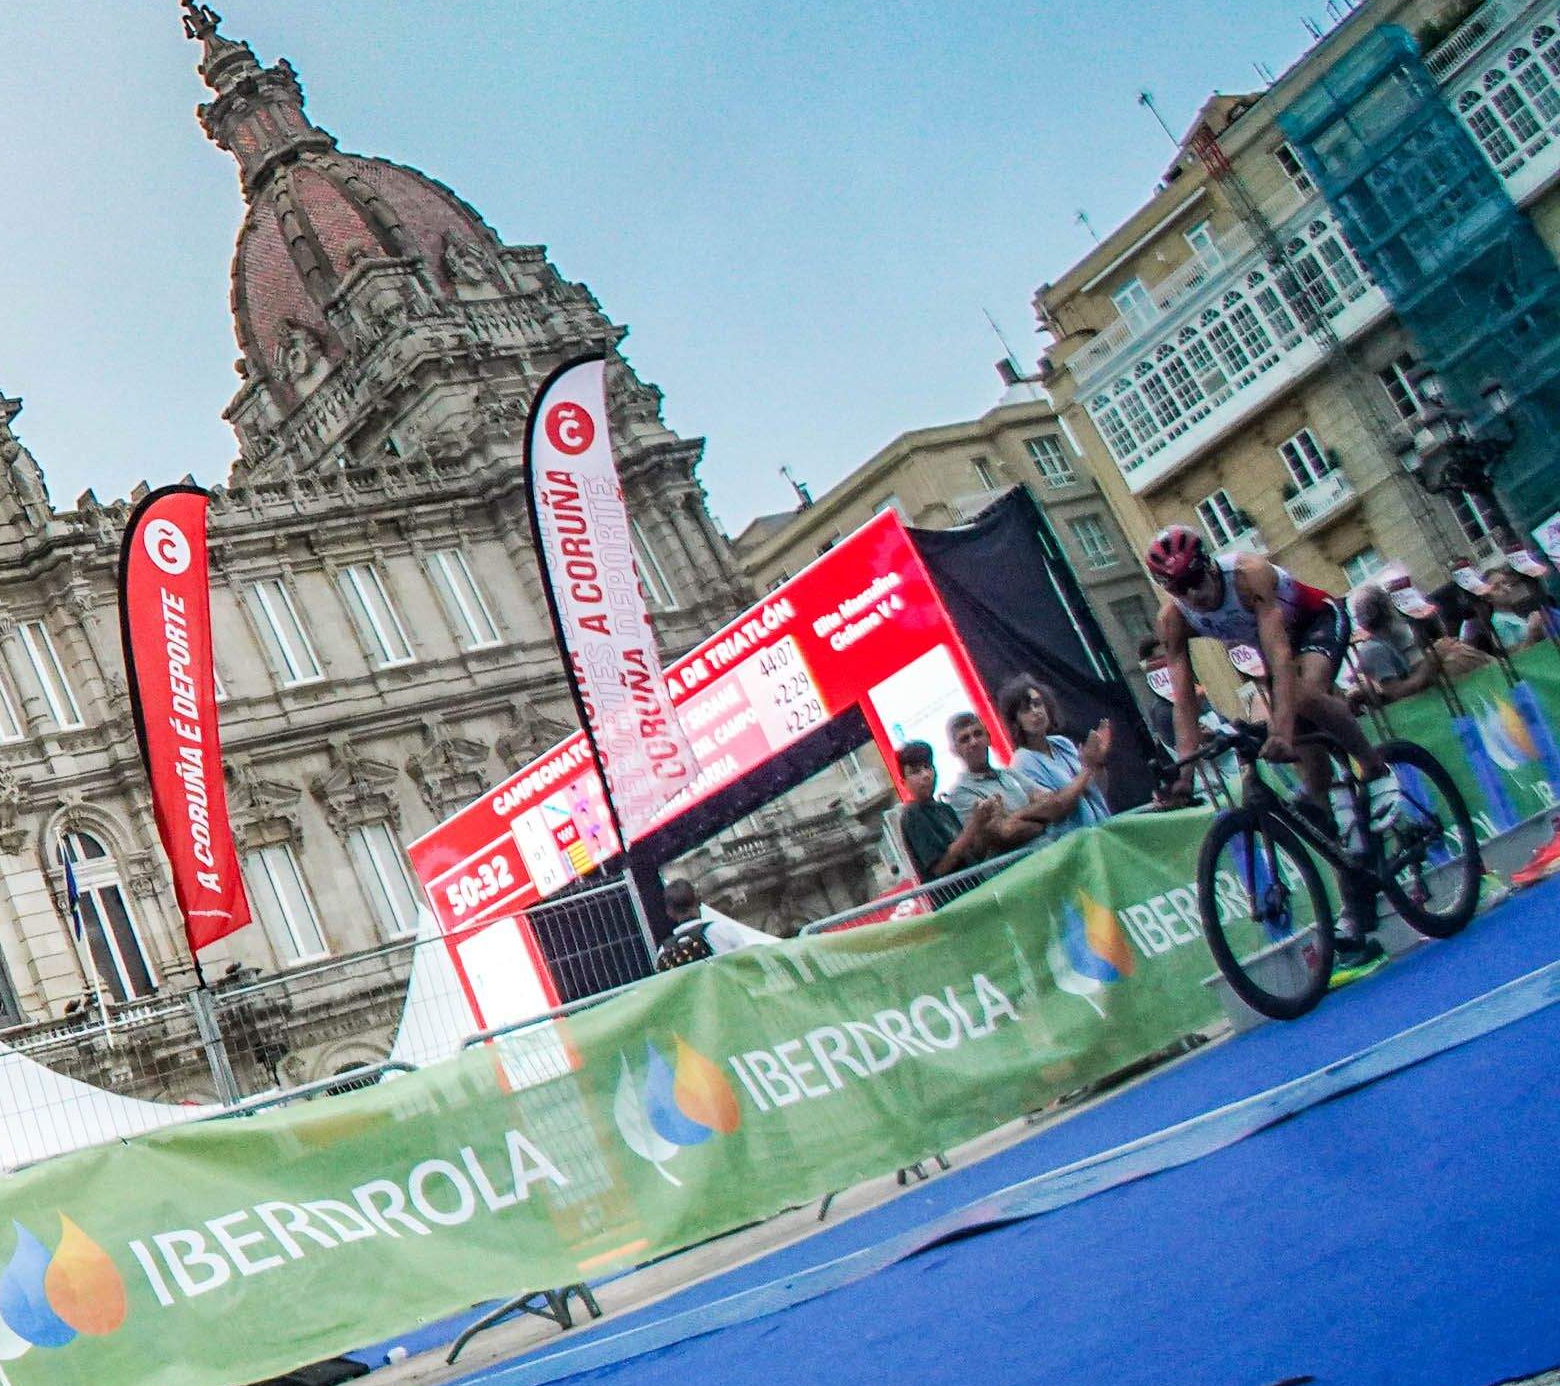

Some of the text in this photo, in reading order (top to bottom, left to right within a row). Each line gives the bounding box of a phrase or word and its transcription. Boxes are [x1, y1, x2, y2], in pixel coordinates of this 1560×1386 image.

[679, 660, 712, 689] DE
[705, 597, 797, 670] TRIATLÓN
[160, 587, 223, 895] A CORUÑA É DEPORTE
[445, 853, 515, 916] 50:32
[727, 972, 1022, 1113] IBERDROLA
[128, 1128, 570, 1309] IBERDROLA
